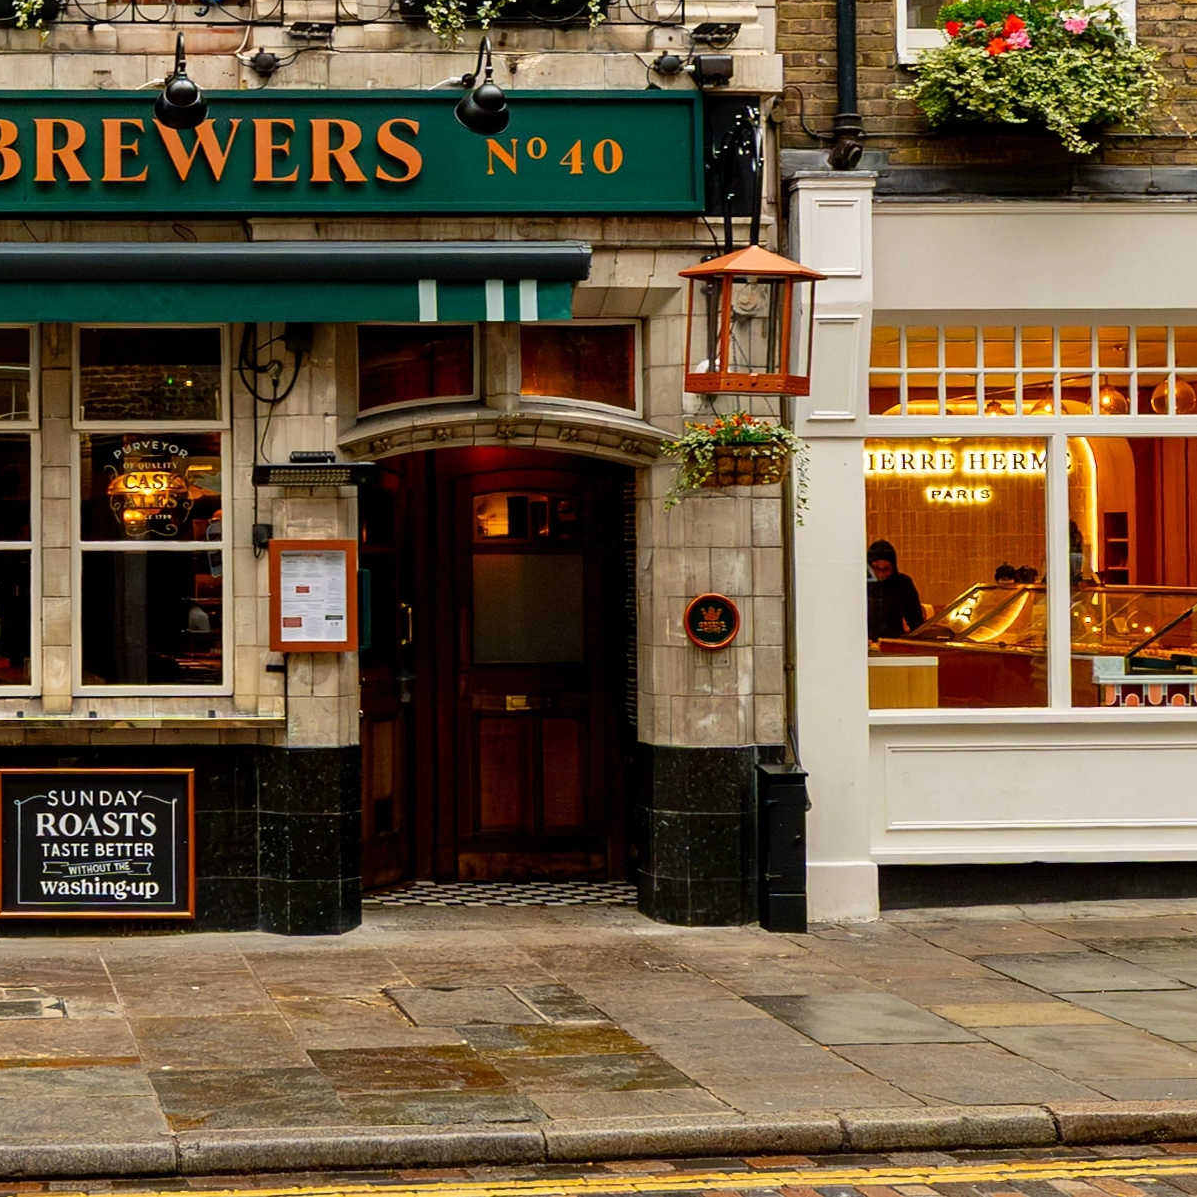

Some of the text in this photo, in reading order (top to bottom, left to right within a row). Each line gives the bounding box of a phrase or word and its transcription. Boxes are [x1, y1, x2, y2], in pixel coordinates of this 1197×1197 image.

[560, 139, 624, 174] 40
[113, 440, 188, 459] PURVEYOR
[867, 453, 956, 471] IERRE
[122, 473, 180, 489] CASK
[931, 489, 991, 500] PARIS
[46, 790, 143, 807] SUNDAY
[35, 812, 158, 837] ROASTS
[40, 843, 155, 857] TASTE BETTER
[68, 861, 131, 875] WITHOUT THE
